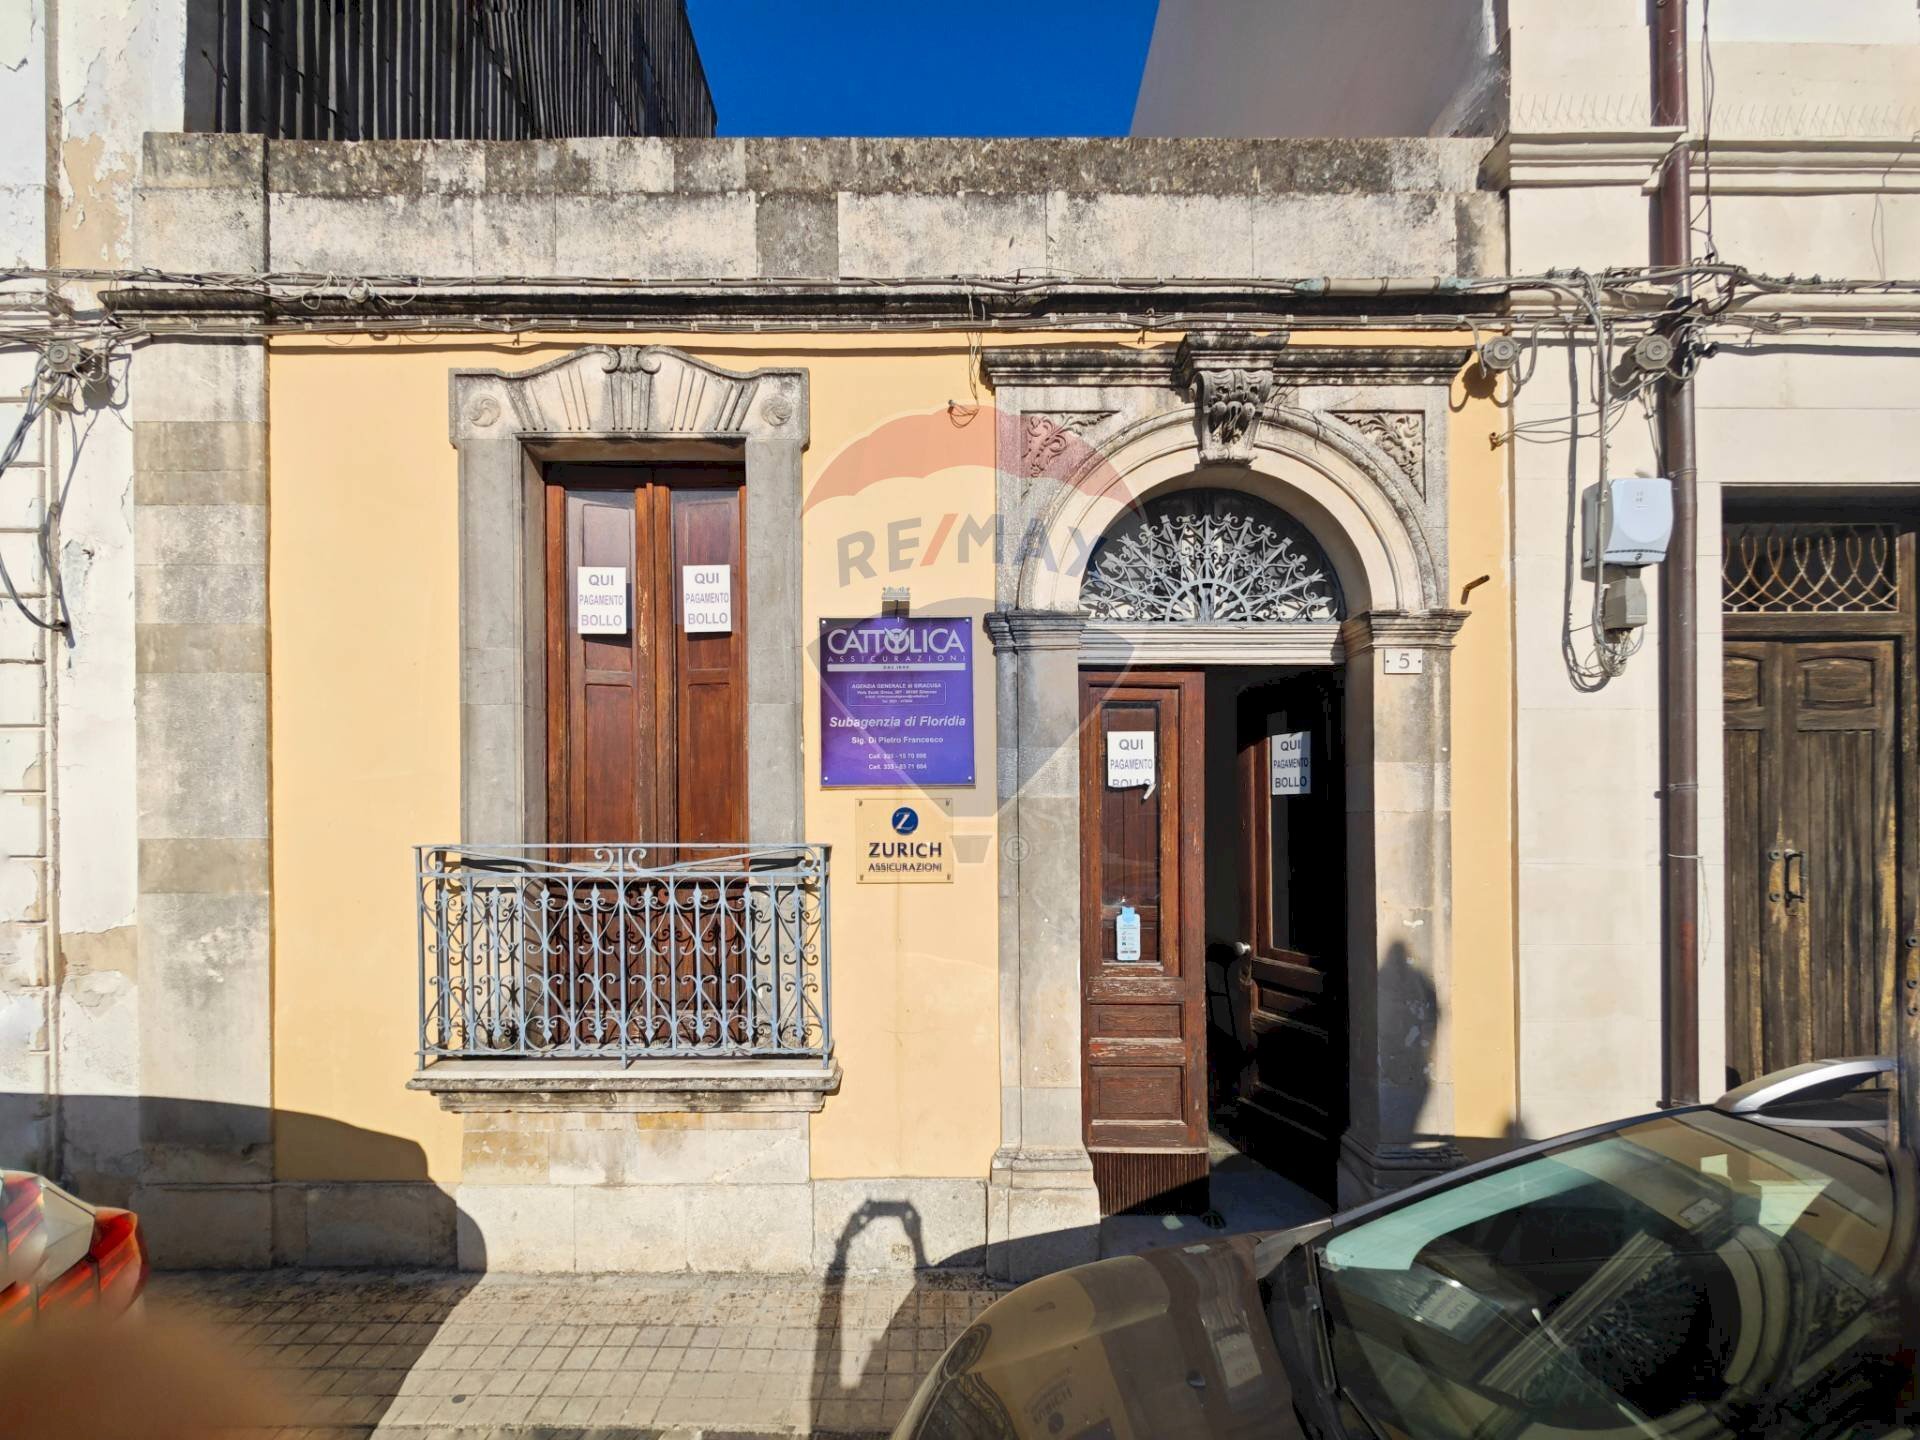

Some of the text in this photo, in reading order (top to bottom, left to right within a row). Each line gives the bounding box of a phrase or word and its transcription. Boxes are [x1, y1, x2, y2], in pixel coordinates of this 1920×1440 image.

[588, 574, 614, 586] QUI
[694, 573, 719, 584] QUI
[579, 594, 623, 606] PAGAMENTO
[685, 592, 729, 604] PAGAMENTO
[581, 614, 622, 627] BOLLO
[688, 612, 728, 625] BOLLO
[827, 628, 965, 654] CATTOLICA
[827, 655, 966, 663] ASSICURAZIONI
[1399, 653, 1409, 669] 5
[829, 715, 966, 729] Subagenzia di Floridia
[851, 737, 865, 745] Sig.
[1119, 739, 1143, 750] QUI
[1280, 740, 1301, 751] QUI
[1110, 759, 1152, 769] PAGAMENTO
[1273, 757, 1309, 768] PAGAMENTO
[1275, 776, 1307, 788] BOLLO
[868, 842, 942, 858] ZURICH
[868, 862, 942, 873] ASSICURAZIONI
